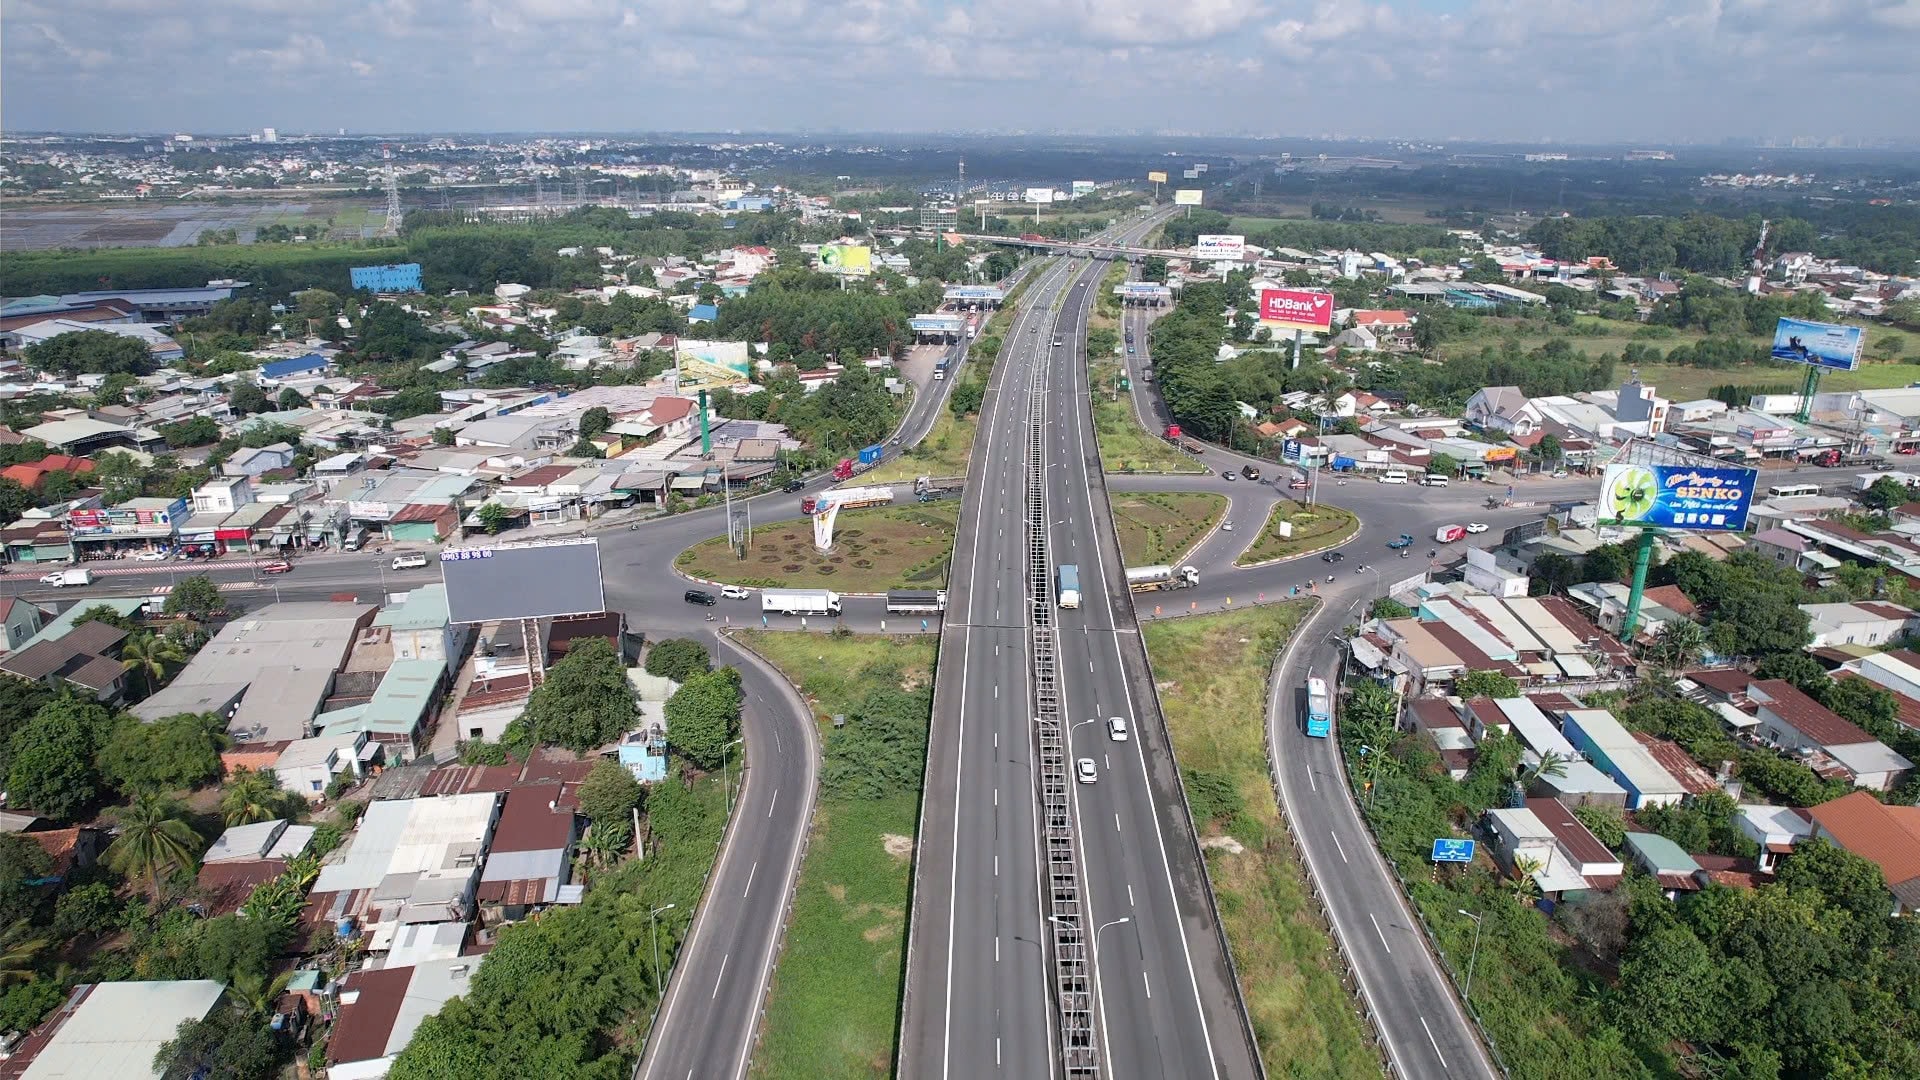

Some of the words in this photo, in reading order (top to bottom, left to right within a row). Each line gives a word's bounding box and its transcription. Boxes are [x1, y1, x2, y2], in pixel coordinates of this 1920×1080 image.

[1269, 298, 1314, 312] HDBank
[1676, 486, 1742, 500] SENKO
[441, 552, 459, 560] 0903
